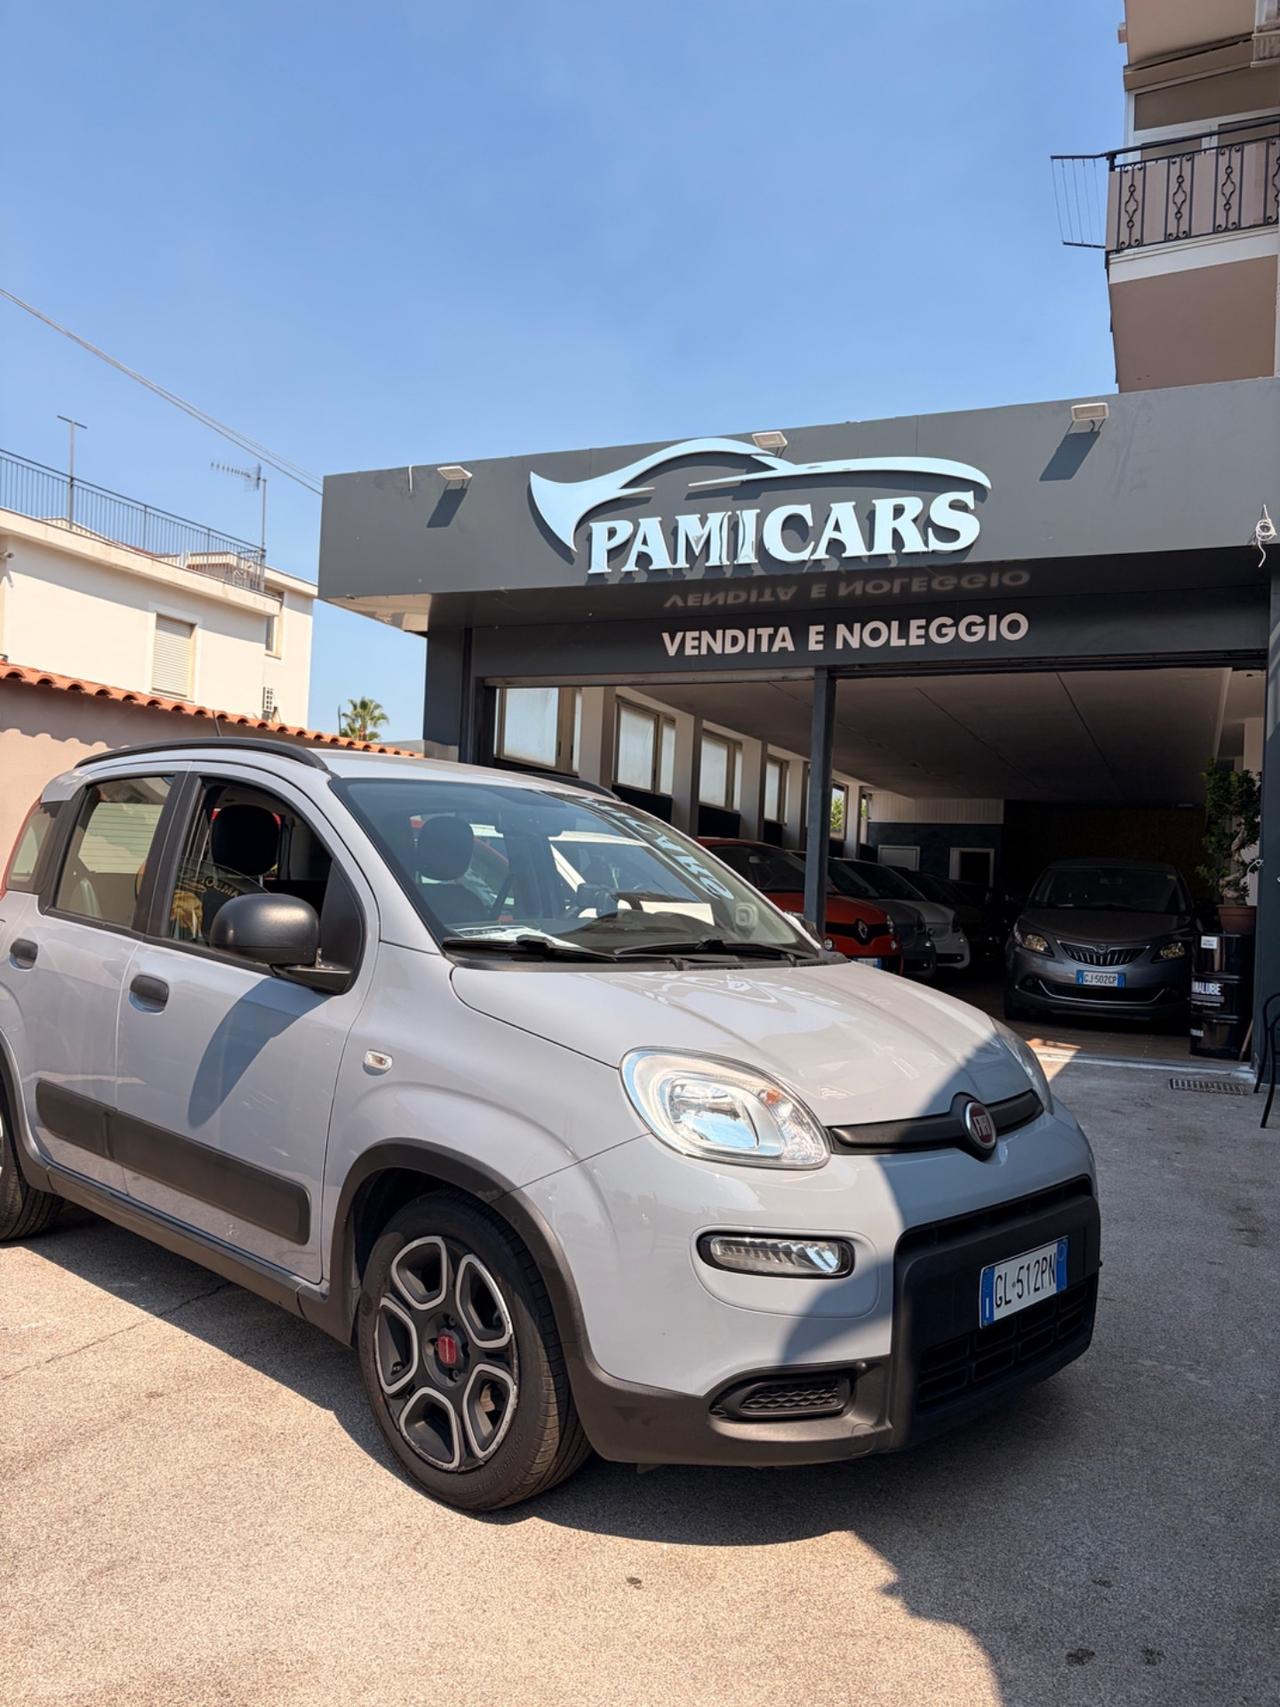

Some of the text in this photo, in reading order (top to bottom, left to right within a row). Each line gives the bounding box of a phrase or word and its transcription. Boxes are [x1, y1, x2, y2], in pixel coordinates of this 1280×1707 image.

[588, 490, 981, 575] PAMICARS
[661, 611, 1030, 657] VENDITA E NOLEGGIO
